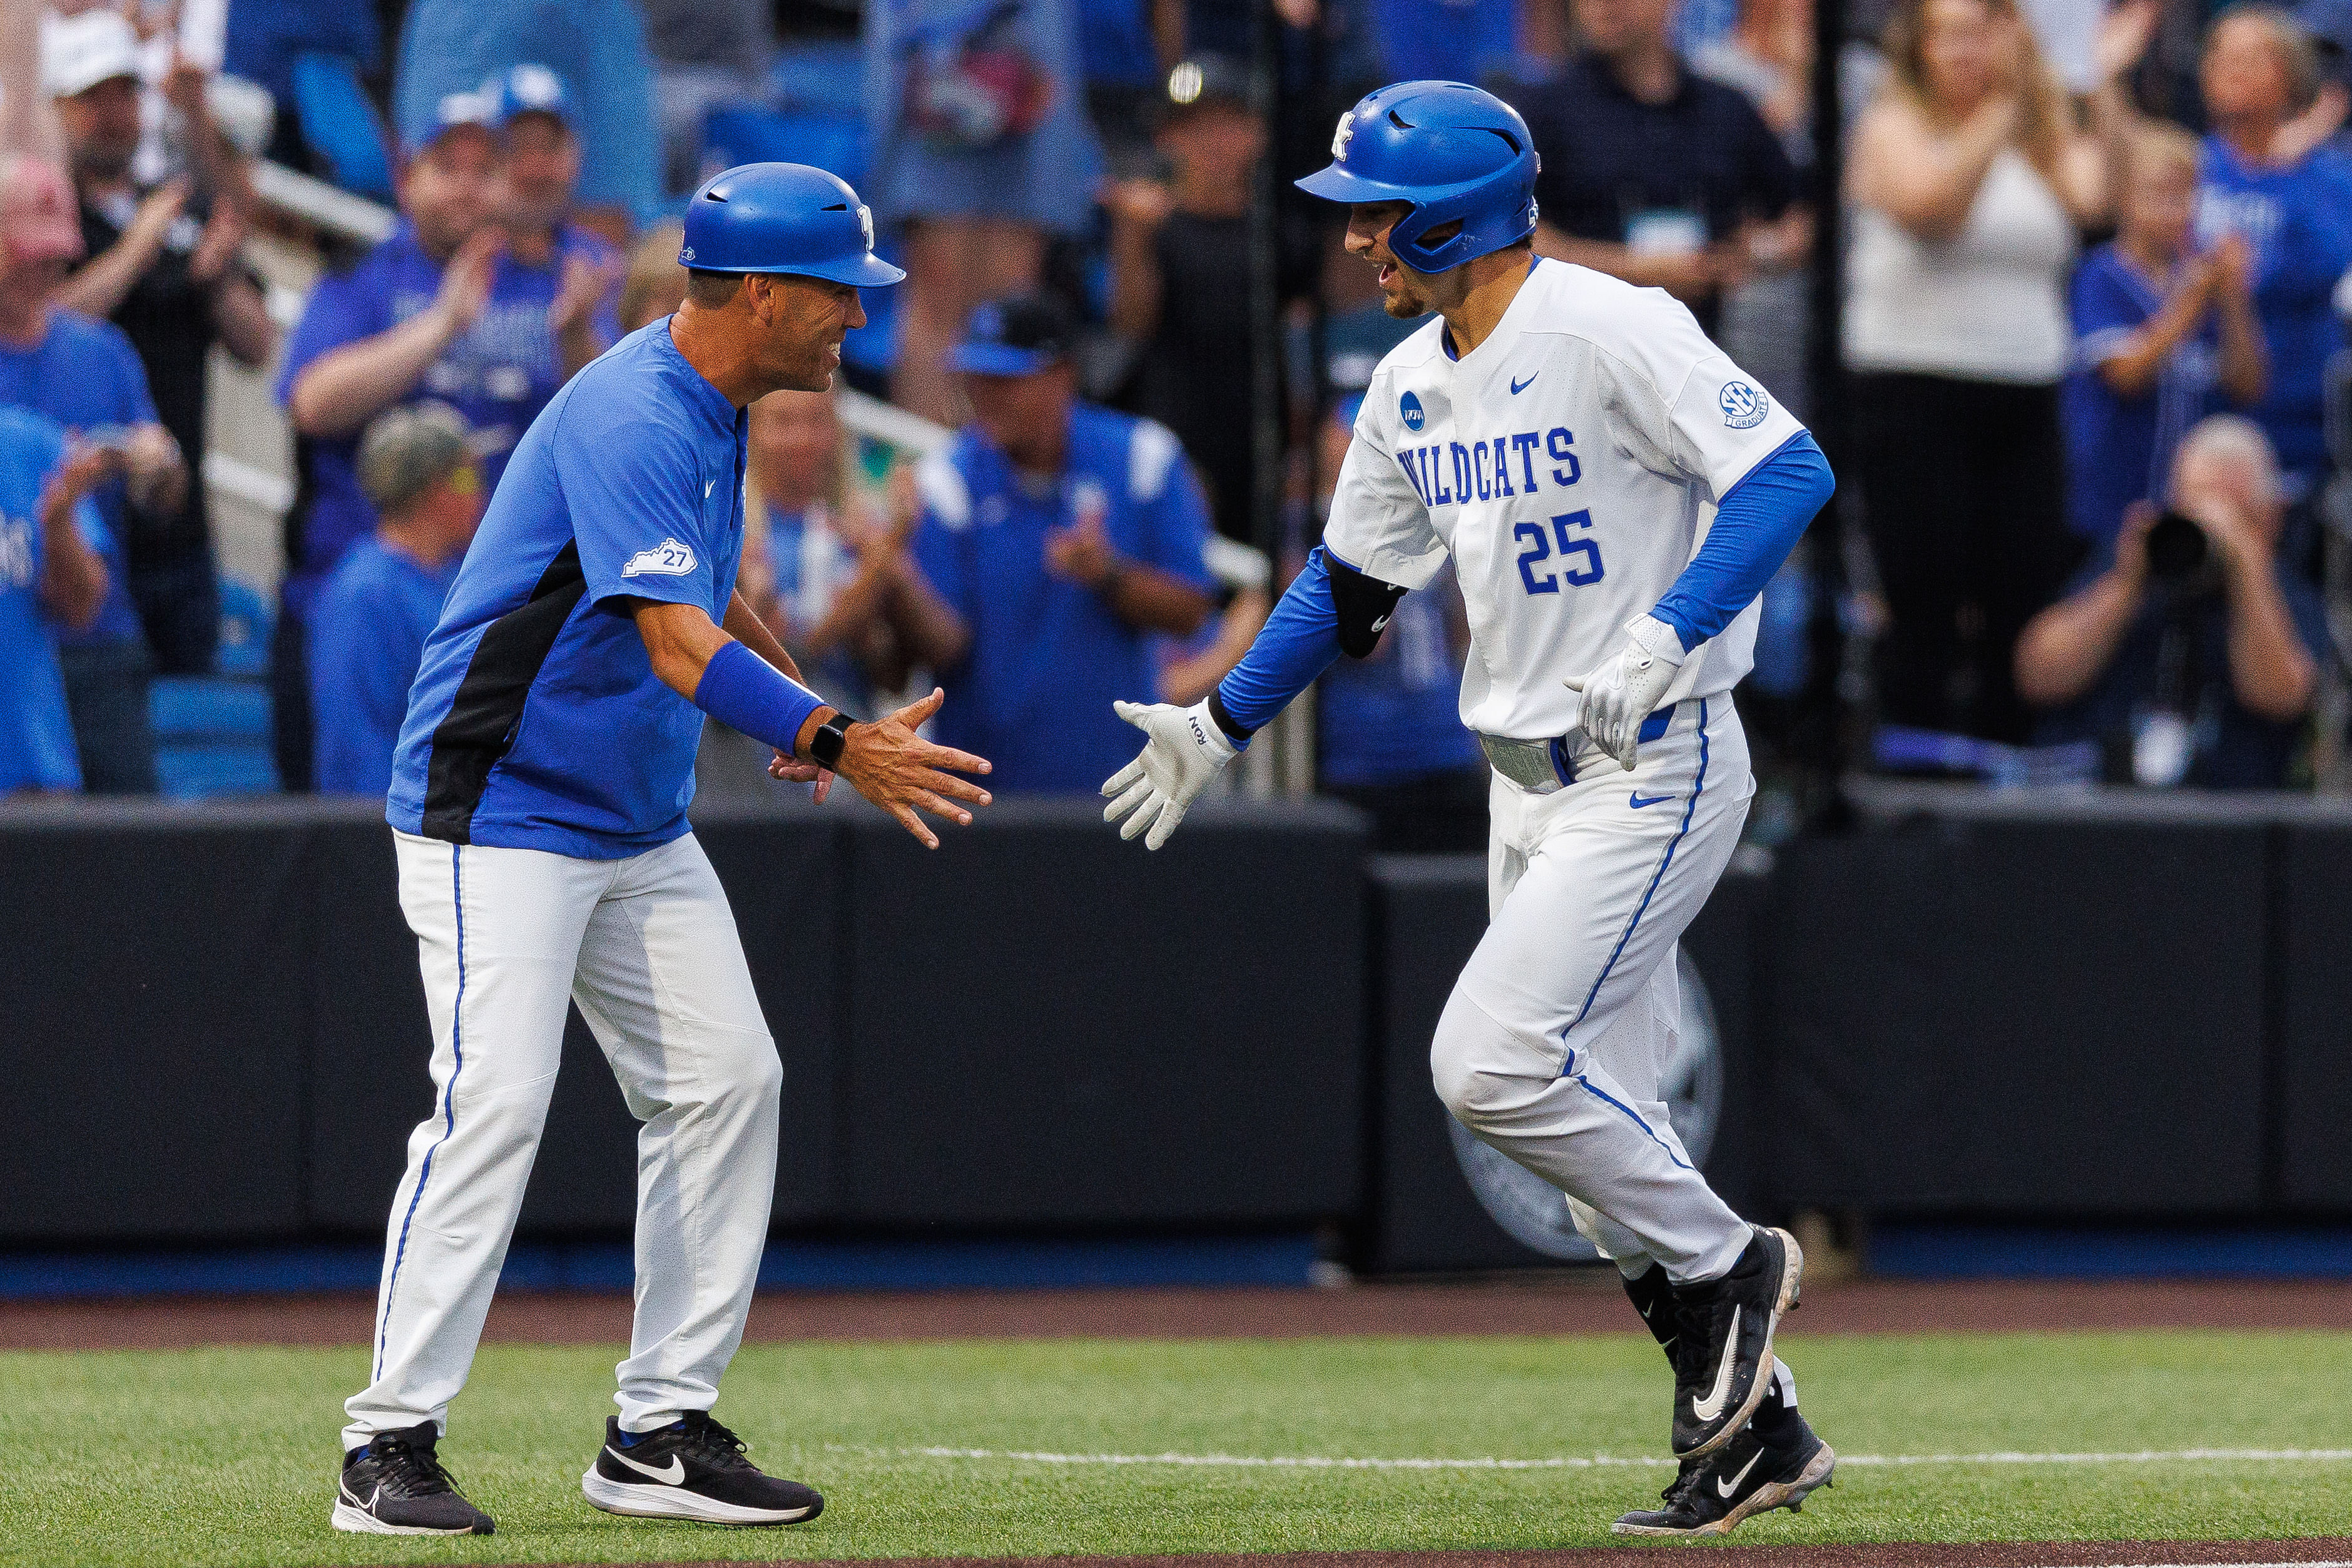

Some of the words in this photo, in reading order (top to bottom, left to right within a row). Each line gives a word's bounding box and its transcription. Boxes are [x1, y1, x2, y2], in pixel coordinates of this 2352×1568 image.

[1721, 382, 1757, 417] SEC
[1735, 401, 1767, 427] GRADUATE
[1397, 427, 1582, 507] WILDCATS
[663, 549, 687, 567] 27
[1514, 508, 1605, 596] 25
